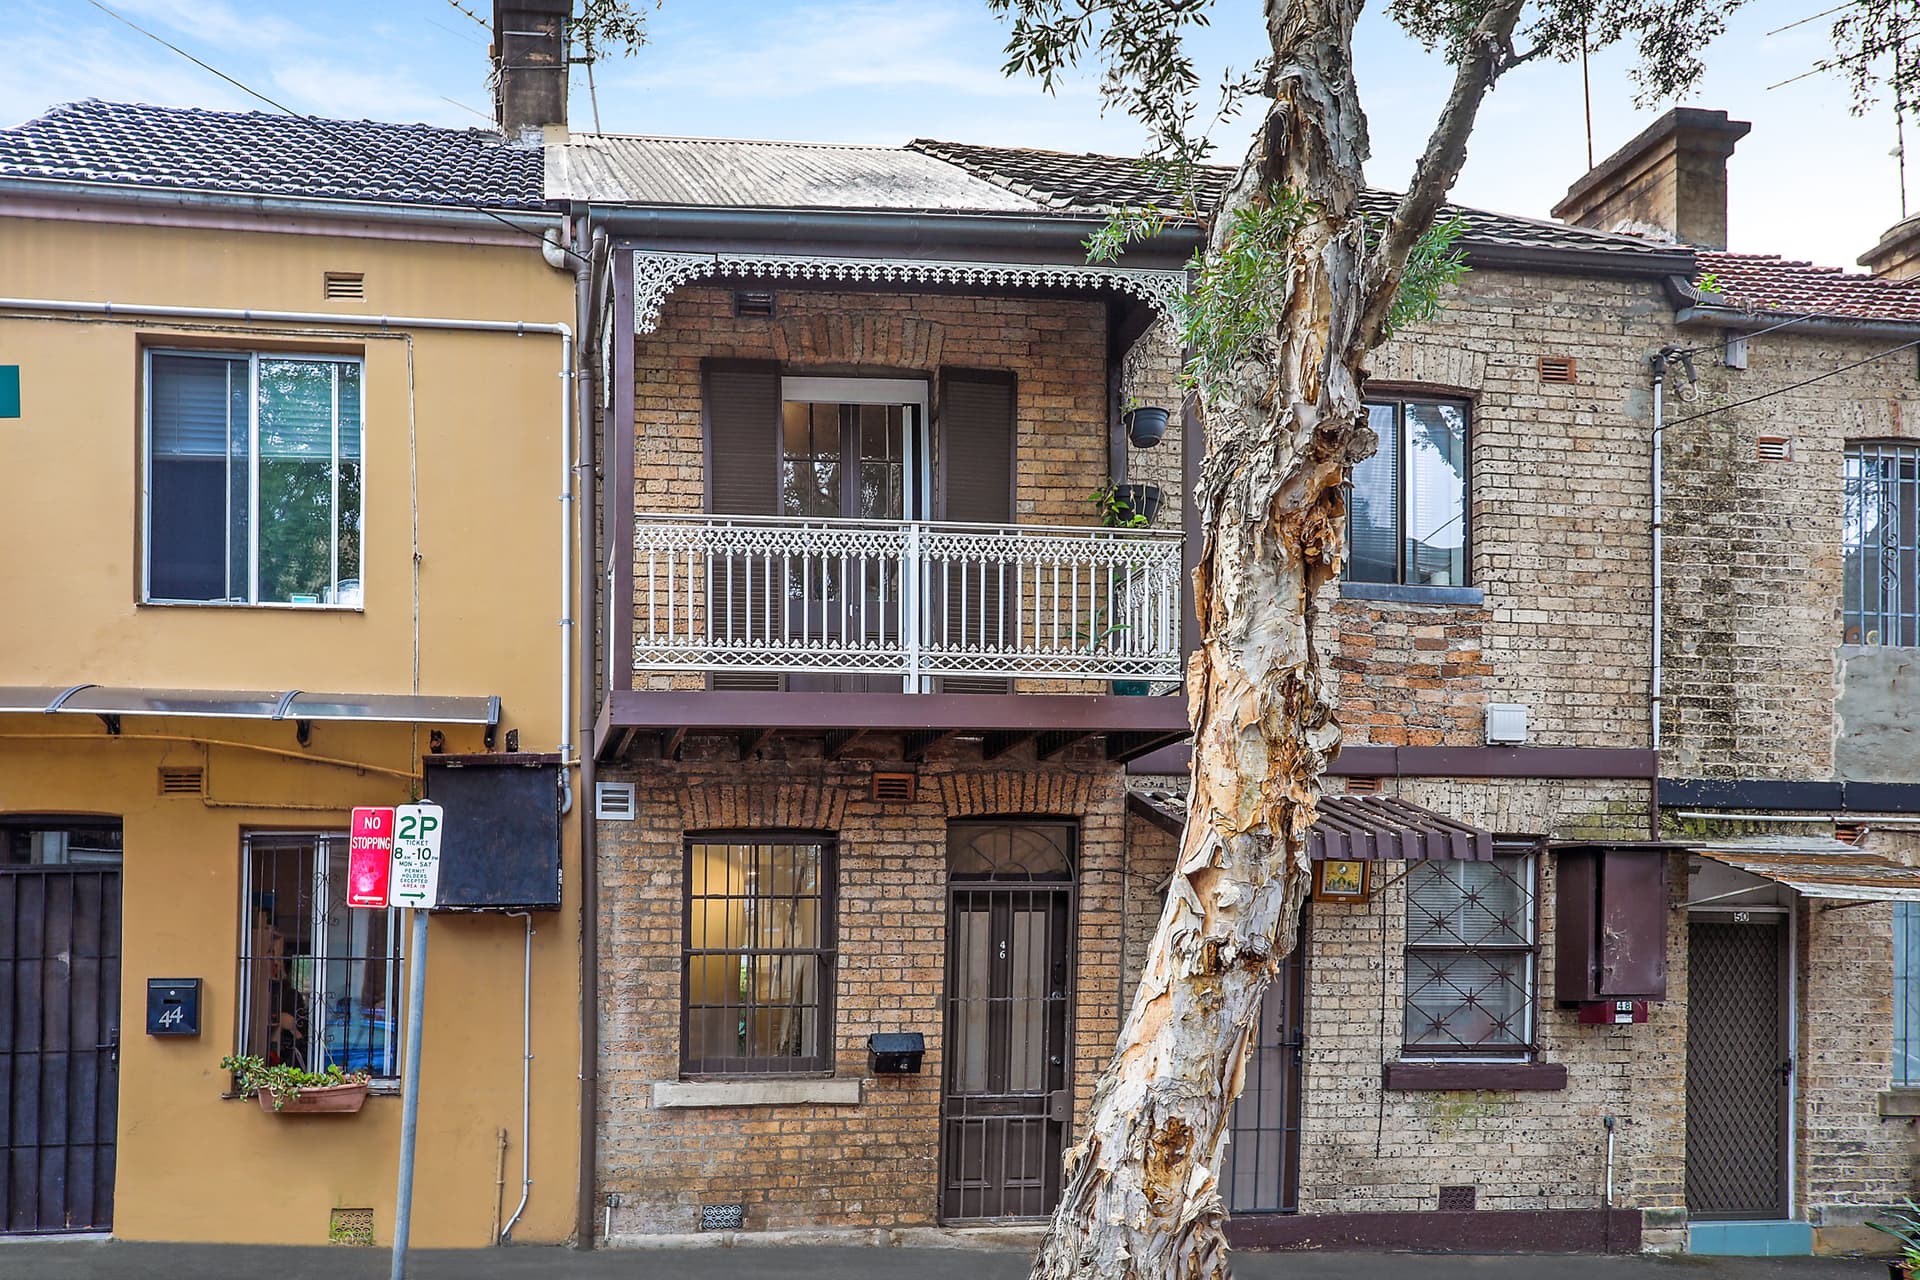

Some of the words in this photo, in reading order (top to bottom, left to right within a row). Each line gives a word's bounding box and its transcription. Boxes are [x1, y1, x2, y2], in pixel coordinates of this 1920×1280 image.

[364, 816, 381, 829] NO
[399, 815, 438, 839] 2P
[352, 836, 391, 850] STOPPING
[1734, 912, 1749, 922] 50
[1617, 1000, 1631, 1010] 48
[158, 1005, 184, 1028] 44
